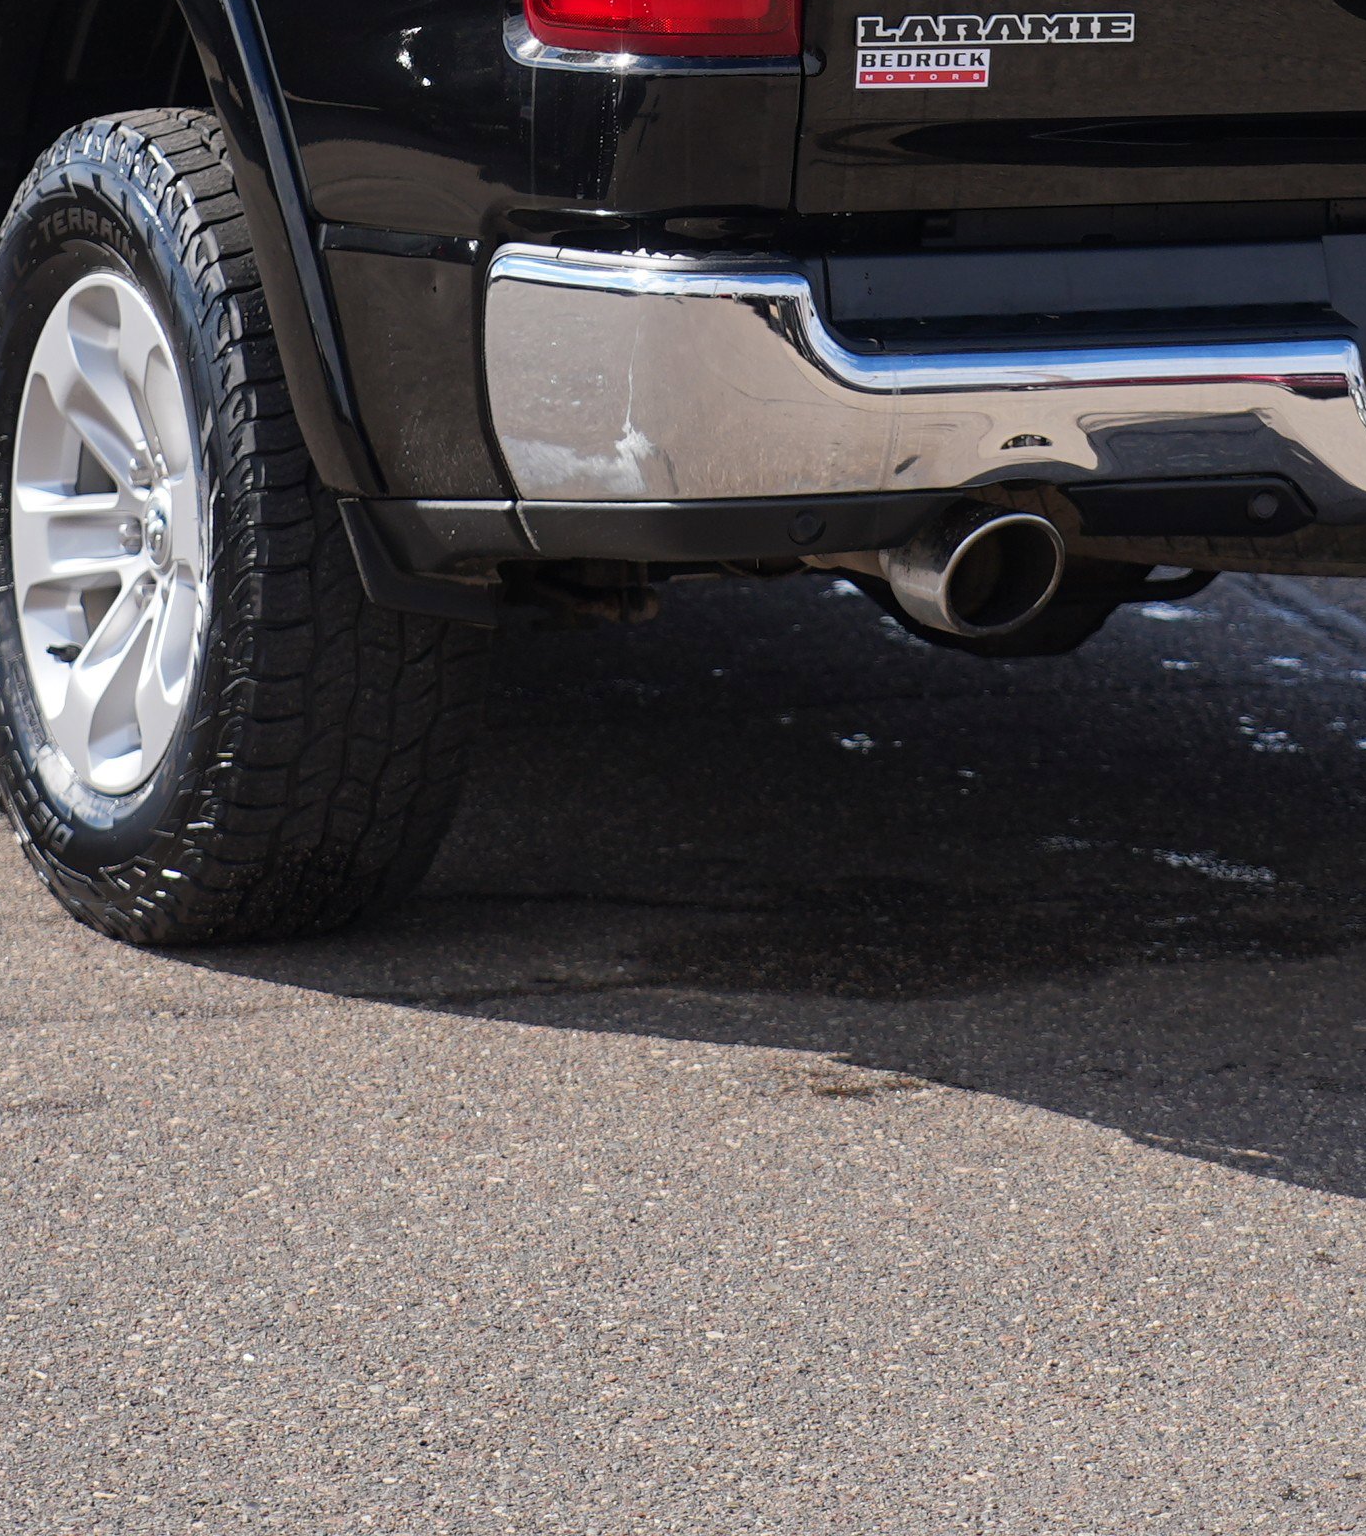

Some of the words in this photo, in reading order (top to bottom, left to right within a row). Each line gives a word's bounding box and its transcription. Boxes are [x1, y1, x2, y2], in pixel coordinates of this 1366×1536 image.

[856, 13, 1135, 46] LARAMIE
[860, 52, 985, 68] BEDROCK
[864, 72, 980, 82] MOTORS
